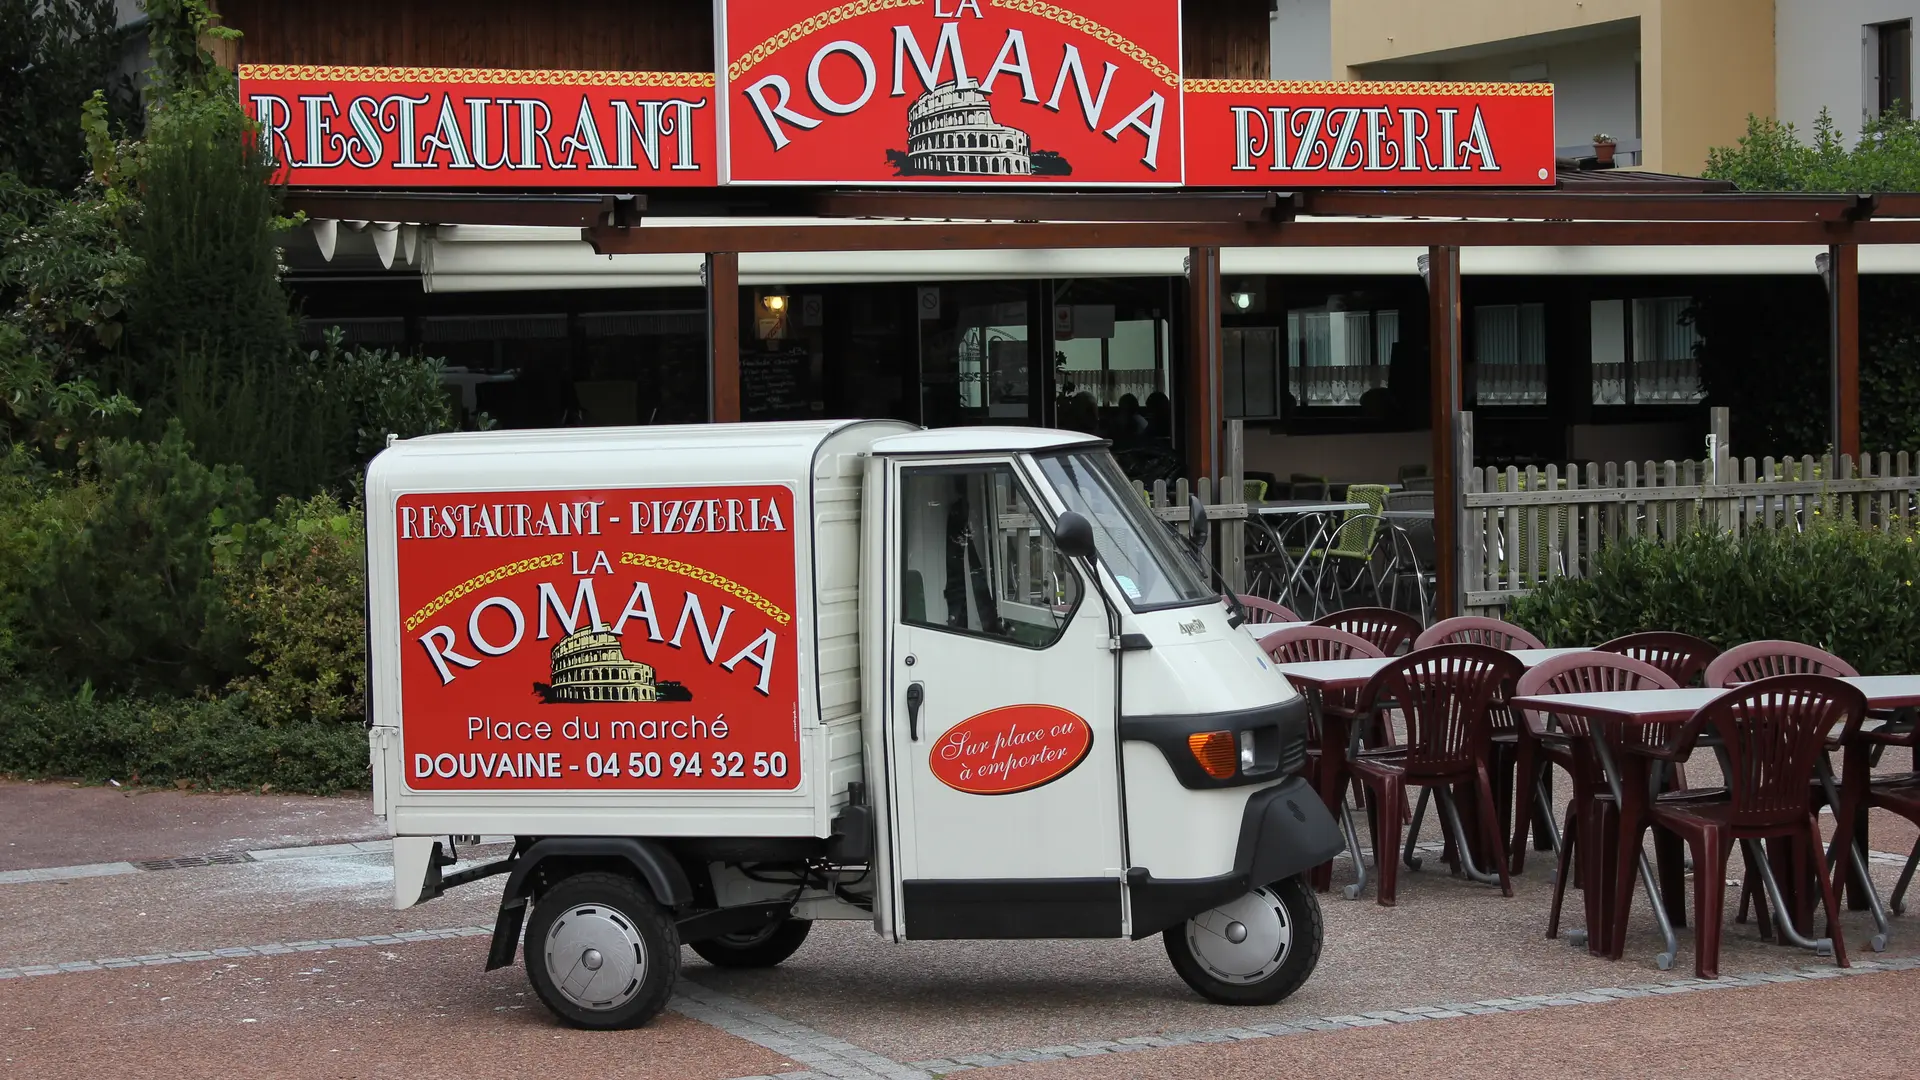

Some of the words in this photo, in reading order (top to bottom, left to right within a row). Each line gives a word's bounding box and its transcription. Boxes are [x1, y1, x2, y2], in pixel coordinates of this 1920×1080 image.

[933, 0, 984, 19] LA
[743, 22, 1166, 172] ROMANA
[248, 92, 707, 172] RESTAURANT
[1229, 103, 1501, 172] PIZZERIA
[400, 500, 605, 540] RESTAURANT
[629, 496, 787, 535] PIZZERIA
[571, 550, 615, 576] LA
[418, 577, 779, 697] ROMANA
[468, 715, 552, 741] Place
[561, 715, 600, 740] du
[610, 713, 730, 740] marché
[941, 730, 990, 760] Sur
[991, 723, 1046, 759] place
[1050, 722, 1076, 736] ou
[414, 752, 562, 779] DOUVAINE
[586, 752, 621, 778] 04
[628, 752, 662, 778] 50
[669, 752, 703, 778] 94
[710, 751, 745, 778] 32
[752, 751, 788, 778] 50
[959, 763, 974, 781] à
[977, 745, 1068, 781] emporter
